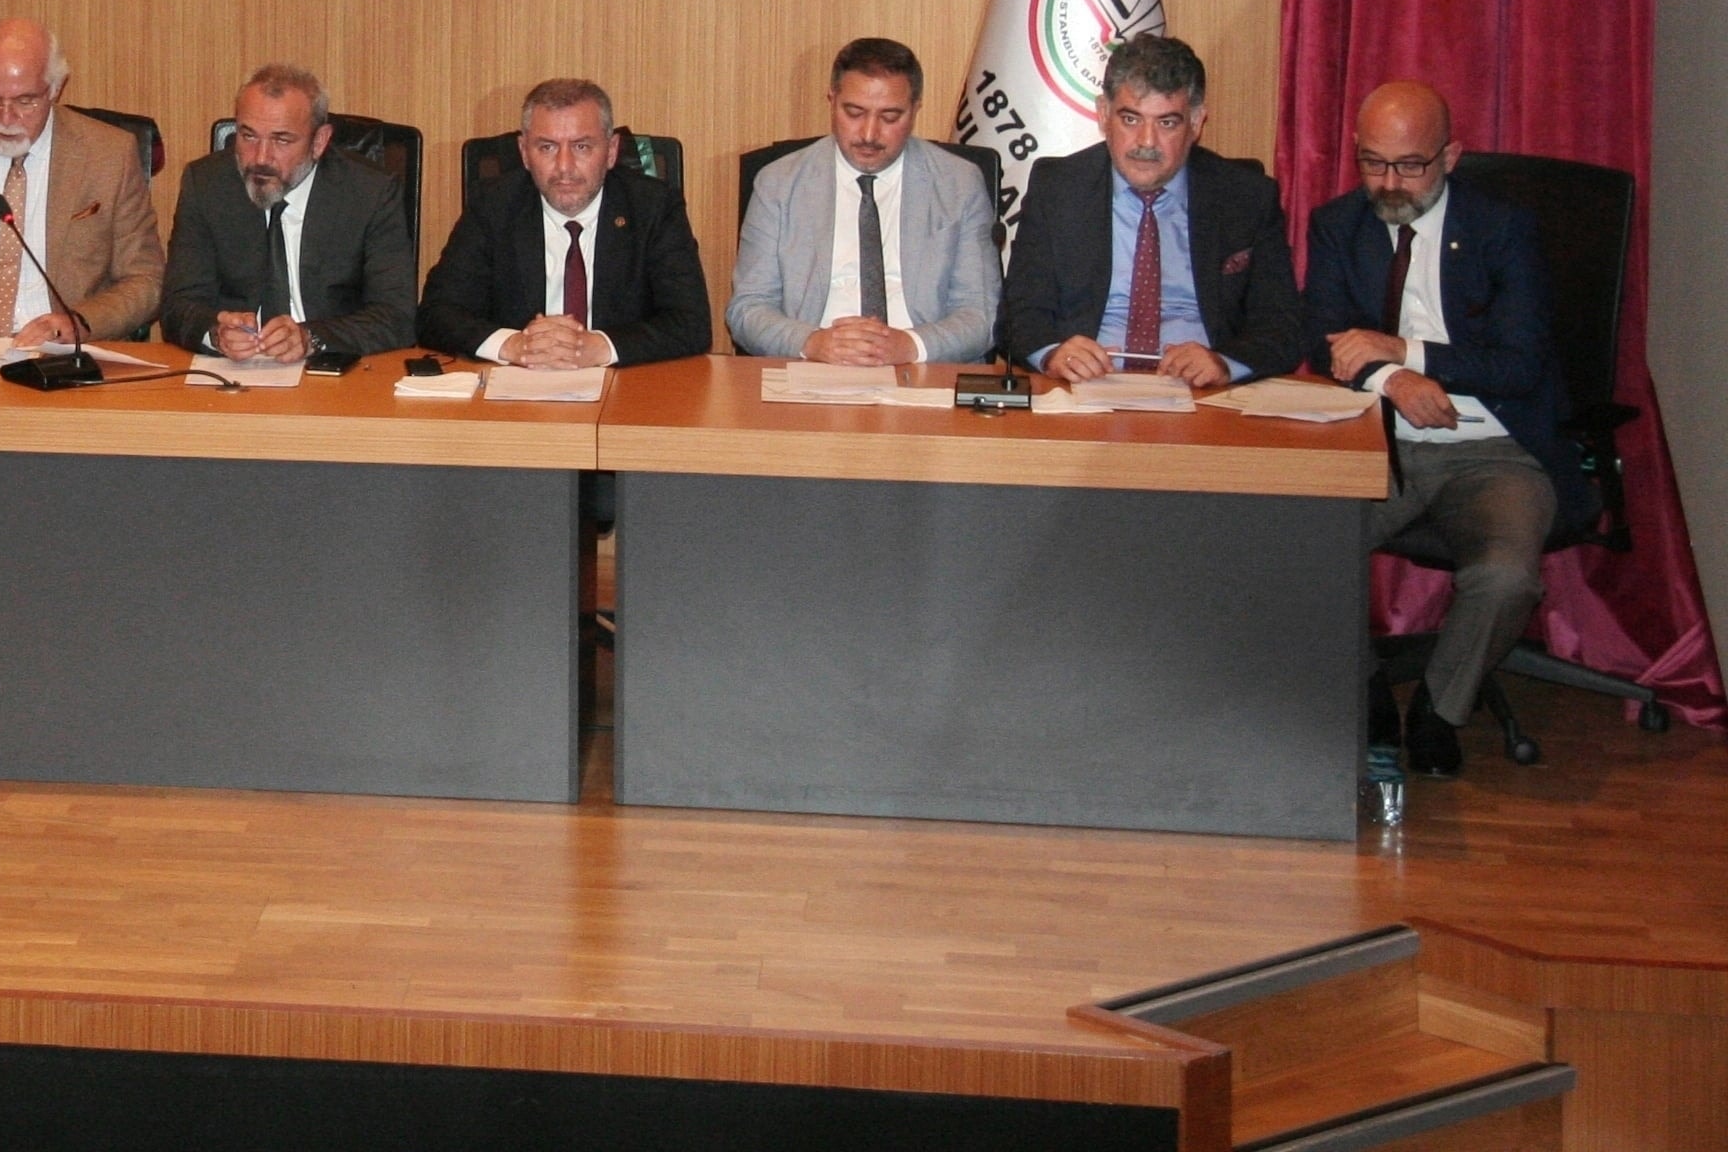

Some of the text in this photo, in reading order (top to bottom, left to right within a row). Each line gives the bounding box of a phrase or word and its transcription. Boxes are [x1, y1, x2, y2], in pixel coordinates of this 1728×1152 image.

[1088, 36, 1108, 62] 1878
[1080, 67, 1105, 89] BAR
[976, 70, 1039, 161] 1878
